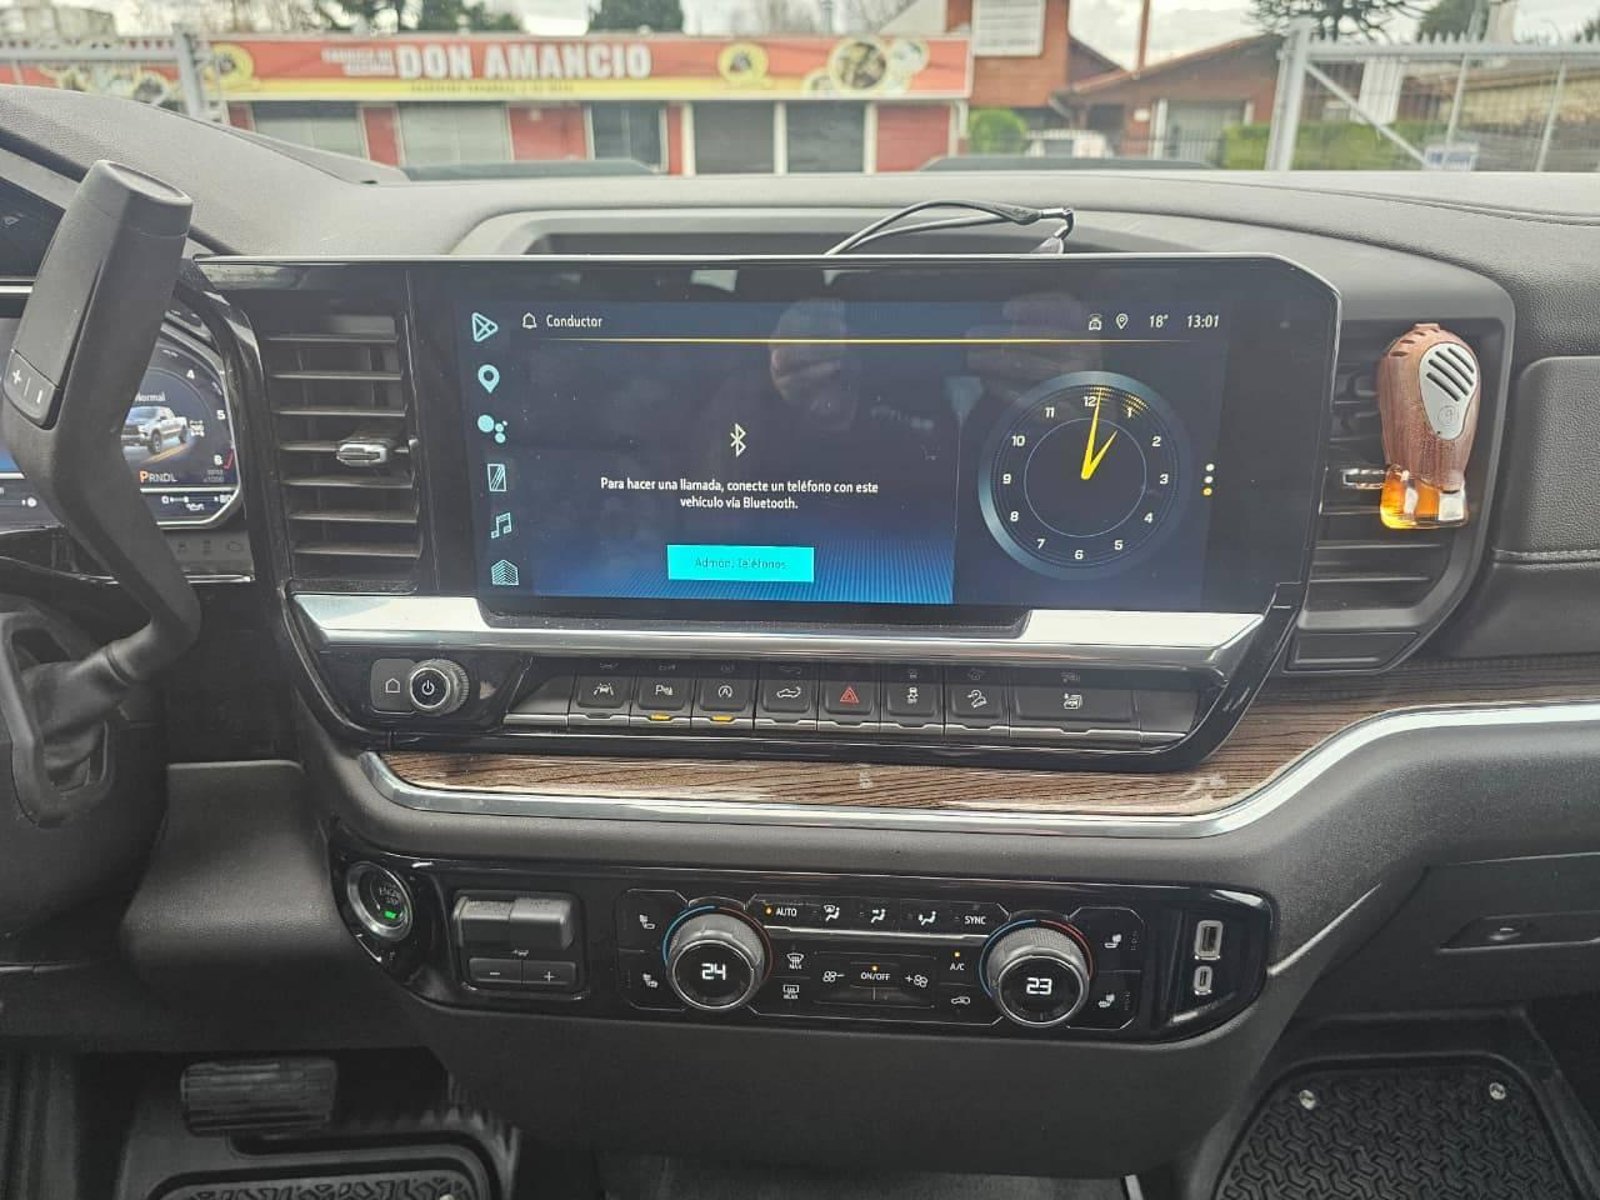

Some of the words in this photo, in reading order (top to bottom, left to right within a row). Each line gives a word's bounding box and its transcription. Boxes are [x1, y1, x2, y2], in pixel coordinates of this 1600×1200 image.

[399, 44, 473, 79] DON
[483, 43, 652, 79] AMANCIO
[546, 314, 602, 328] Conductor
[1186, 314, 1220, 328] 13:01
[186, 369, 195, 379] 4
[1083, 396, 1097, 407] 12
[216, 409, 226, 420] 5
[1045, 407, 1055, 418] 11
[1012, 436, 1026, 447] 10
[1152, 436, 1162, 447] 2
[1003, 474, 1012, 485] 9
[1159, 474, 1169, 485] 3
[600, 477, 624, 490] Para
[626, 477, 656, 491] hacer
[658, 480, 678, 491] una
[680, 478, 724, 493] llamada,
[727, 480, 768, 492] conecte
[771, 483, 784, 493] un
[787, 480, 831, 493] teléfono
[834, 483, 853, 494] con
[856, 482, 879, 494] este
[680, 496, 724, 509] vehículo
[726, 497, 741, 509] vía
[743, 497, 799, 510] Bluetooth.
[1010, 511, 1019, 522] 8
[1144, 512, 1154, 523] 4
[1037, 538, 1046, 550] 7
[1114, 539, 1124, 550] 5
[1074, 550, 1084, 560] 6
[775, 907, 797, 918] AUTO
[964, 915, 986, 926] SYNC
[701, 963, 727, 981] 24
[950, 963, 965, 972] A/C
[860, 972, 891, 982] ON/OFF
[1026, 977, 1053, 996] 23
